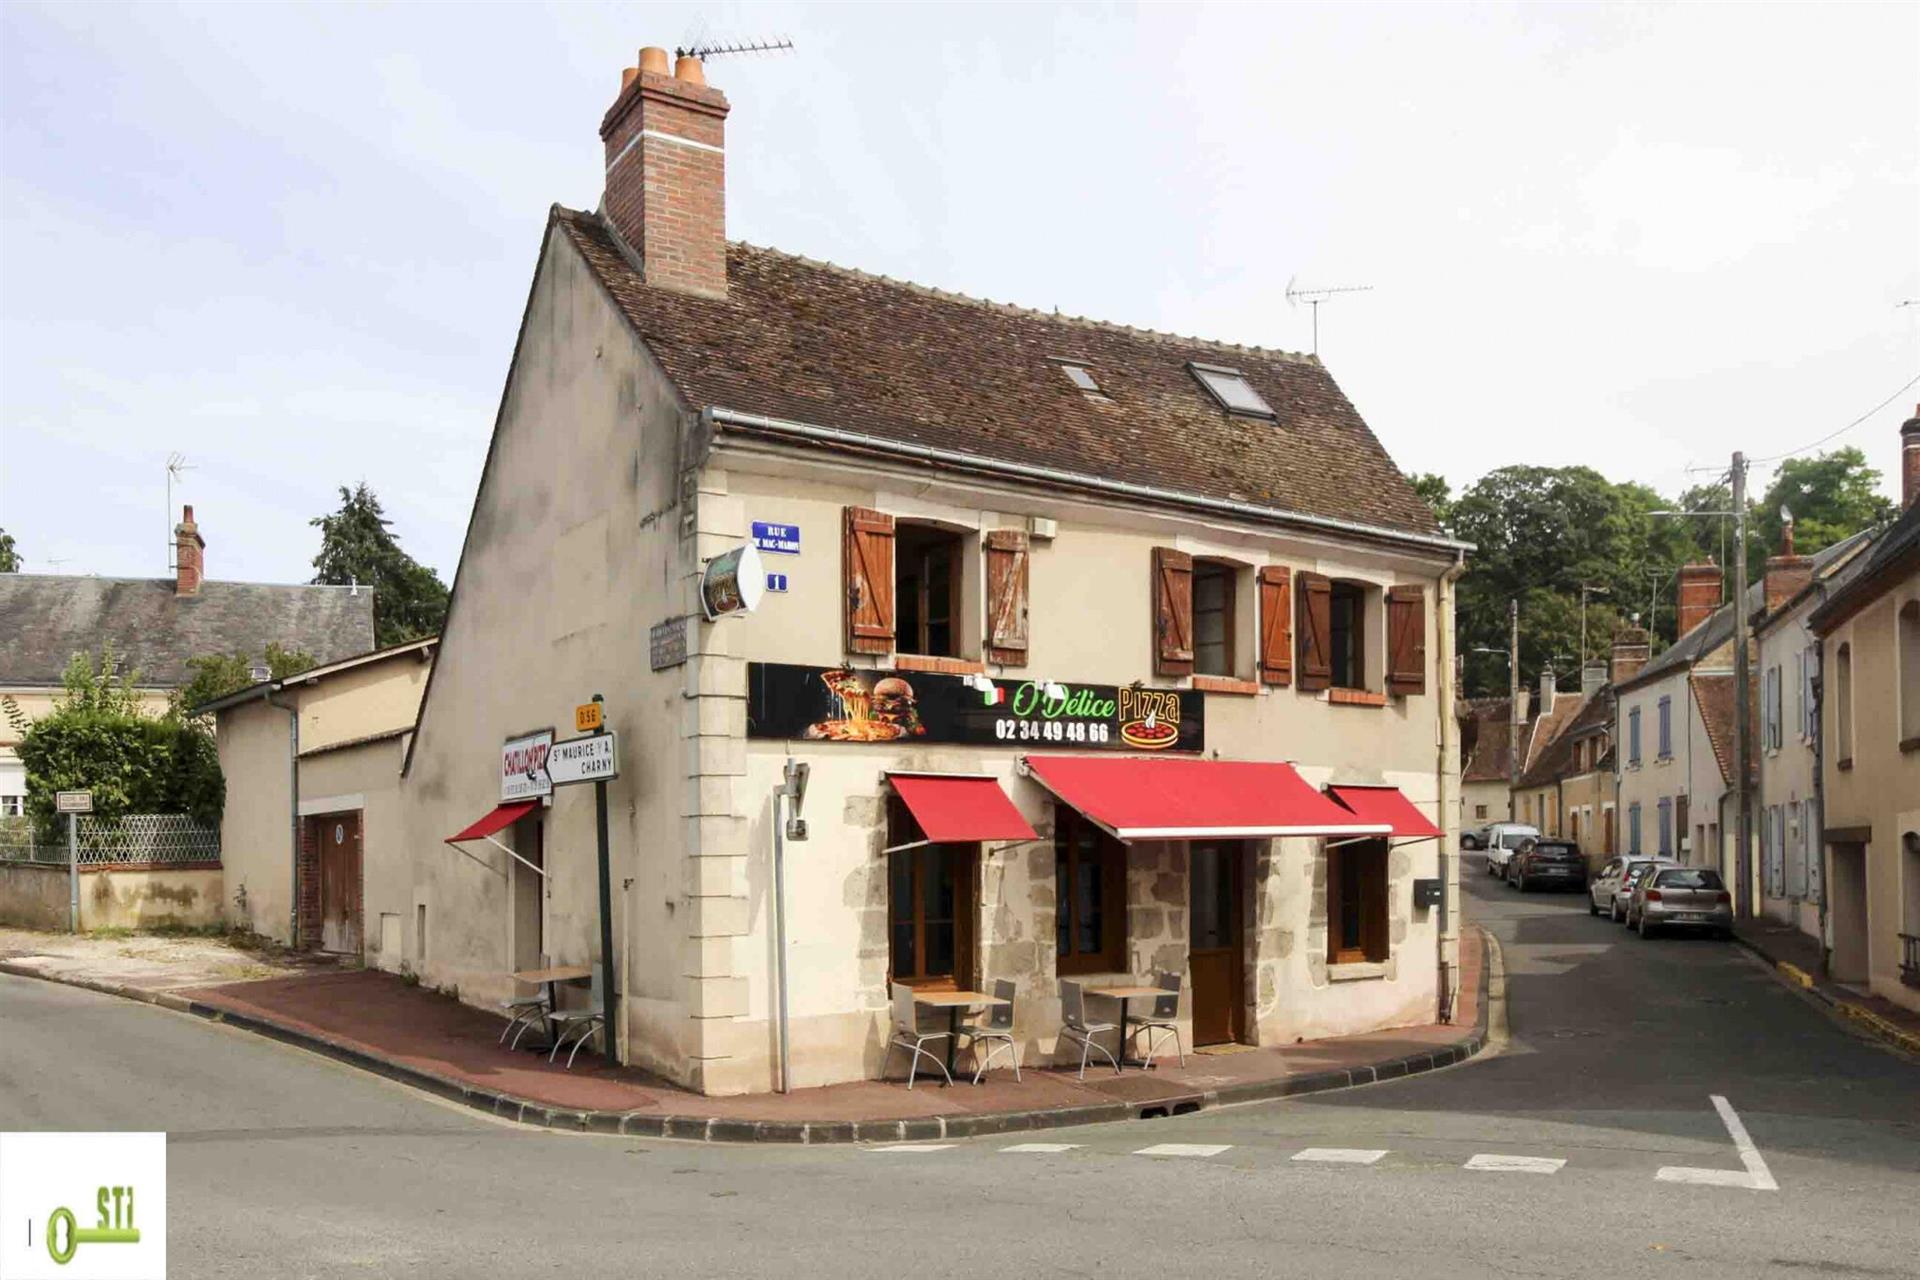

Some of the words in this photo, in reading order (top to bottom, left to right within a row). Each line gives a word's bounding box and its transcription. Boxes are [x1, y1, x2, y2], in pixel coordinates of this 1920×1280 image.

[768, 526, 787, 537] RUE
[774, 575, 780, 590] 1
[996, 719, 1016, 739] 02
[1020, 720, 1040, 740] 34
[1043, 721, 1063, 741] 49
[1066, 722, 1086, 741] 48
[1089, 722, 1109, 742] 66
[562, 743, 594, 759] MAURICE
[581, 759, 612, 775] CHARNY
